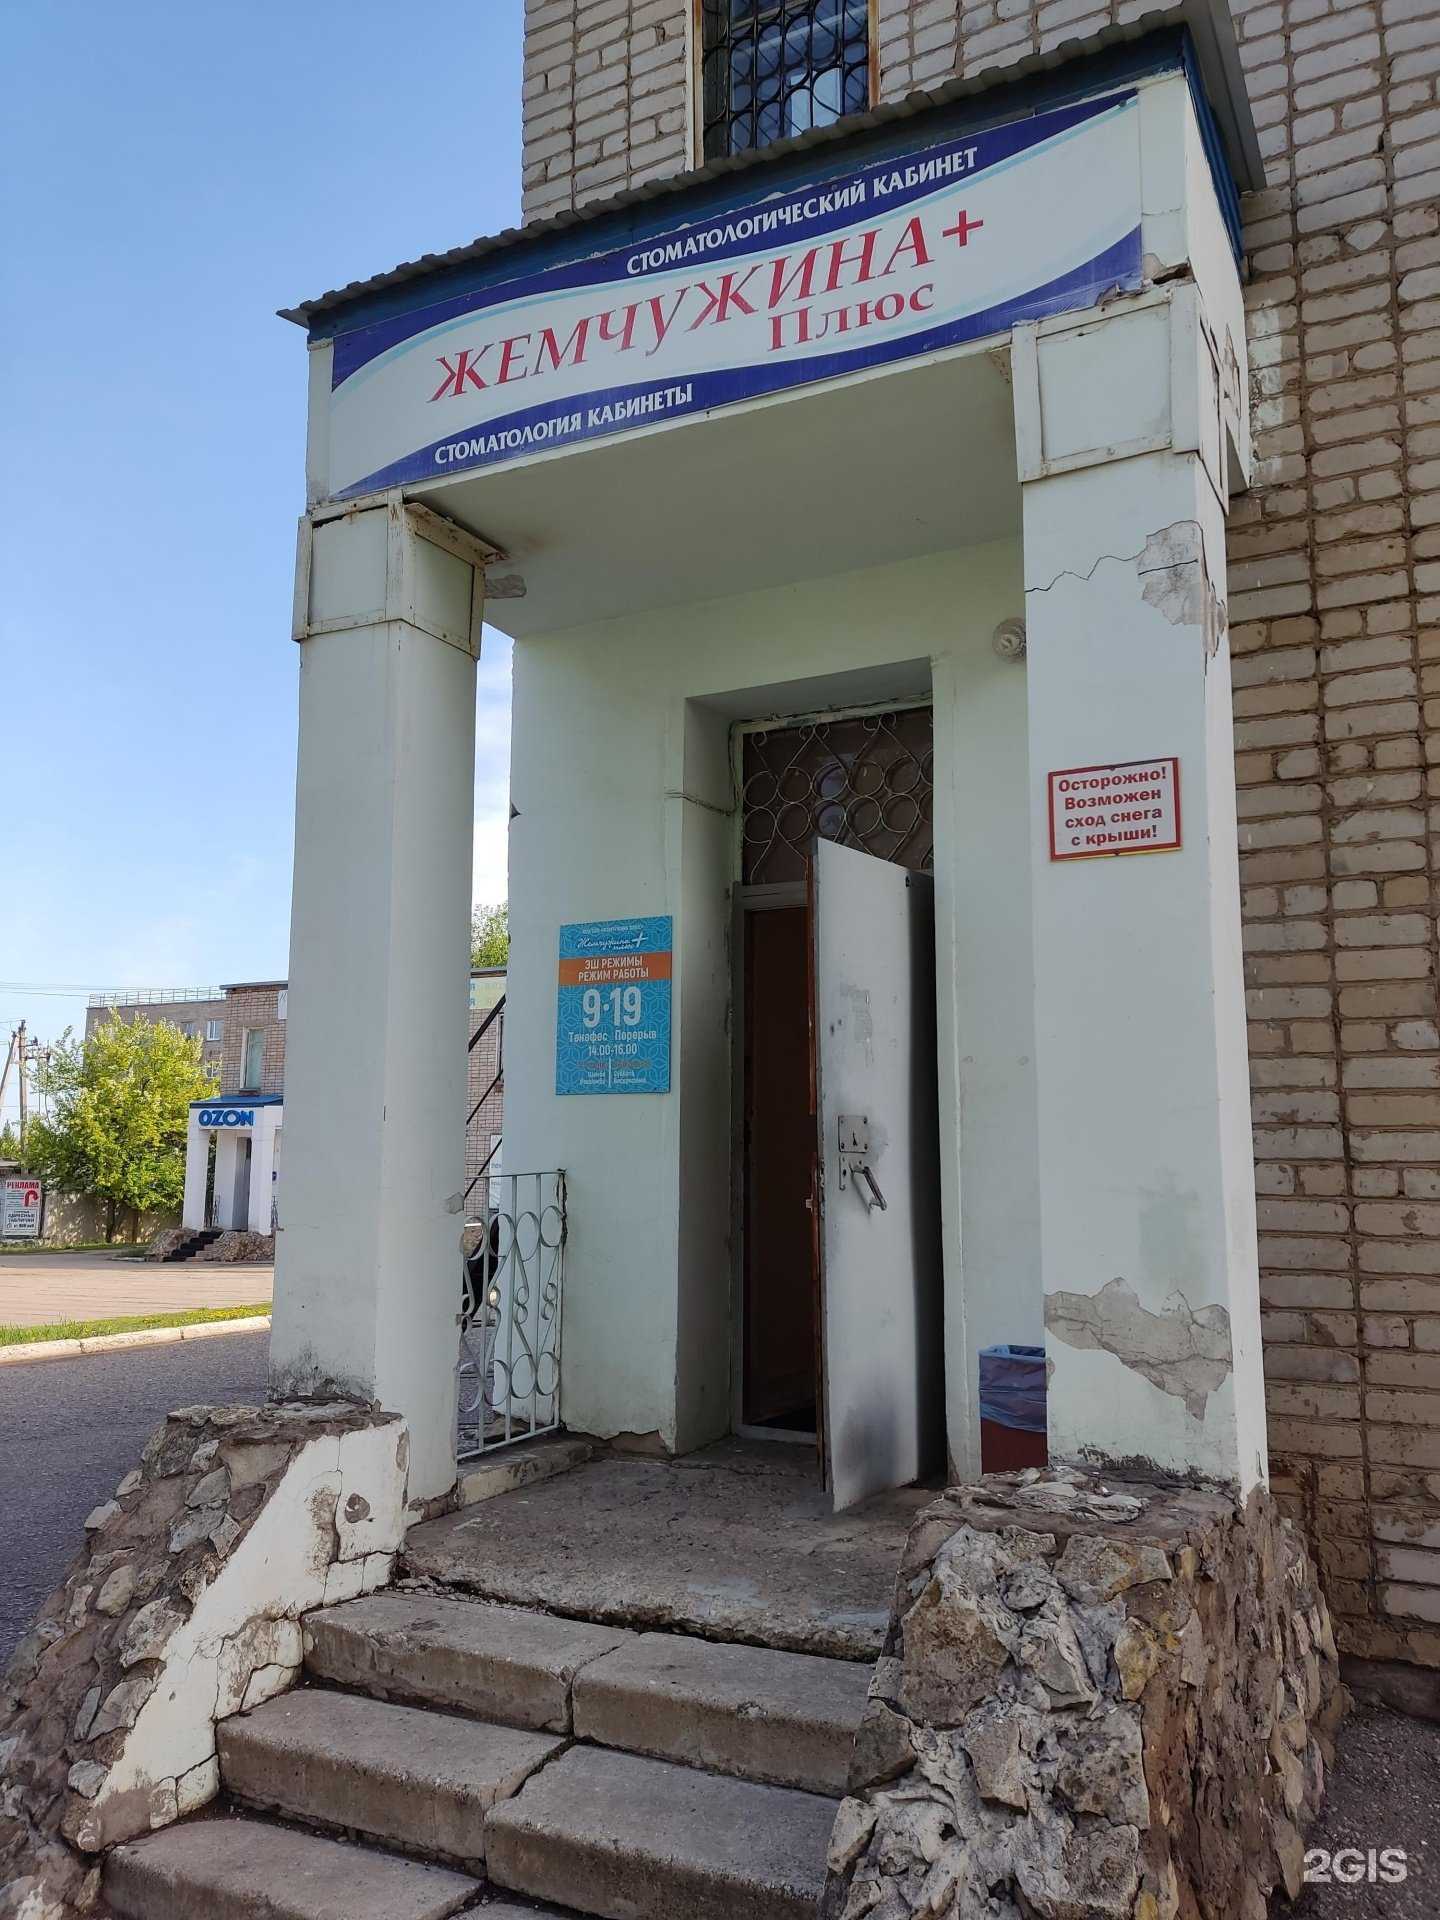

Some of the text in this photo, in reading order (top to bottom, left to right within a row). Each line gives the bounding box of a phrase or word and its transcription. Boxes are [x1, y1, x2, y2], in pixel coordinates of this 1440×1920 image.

[627, 147, 979, 275] СТОМАТОЛОГИЧЕСКИЙ КАБИНЕТ
[768, 283, 935, 352] Плюс
[434, 383, 693, 465] СТОМАТОЛОГИЯ КАБИНЕТЫ
[1058, 766, 1167, 793] Осторожно!
[1064, 789, 1162, 811] Возможен
[1065, 807, 1163, 829] сход снега
[1071, 824, 1157, 847] с крыши!
[585, 955, 643, 969] ЭШ РЕЖИМЫ
[578, 967, 649, 983] РЕЖИМ РАБОТЫ
[198, 1109, 254, 1127] OZON
